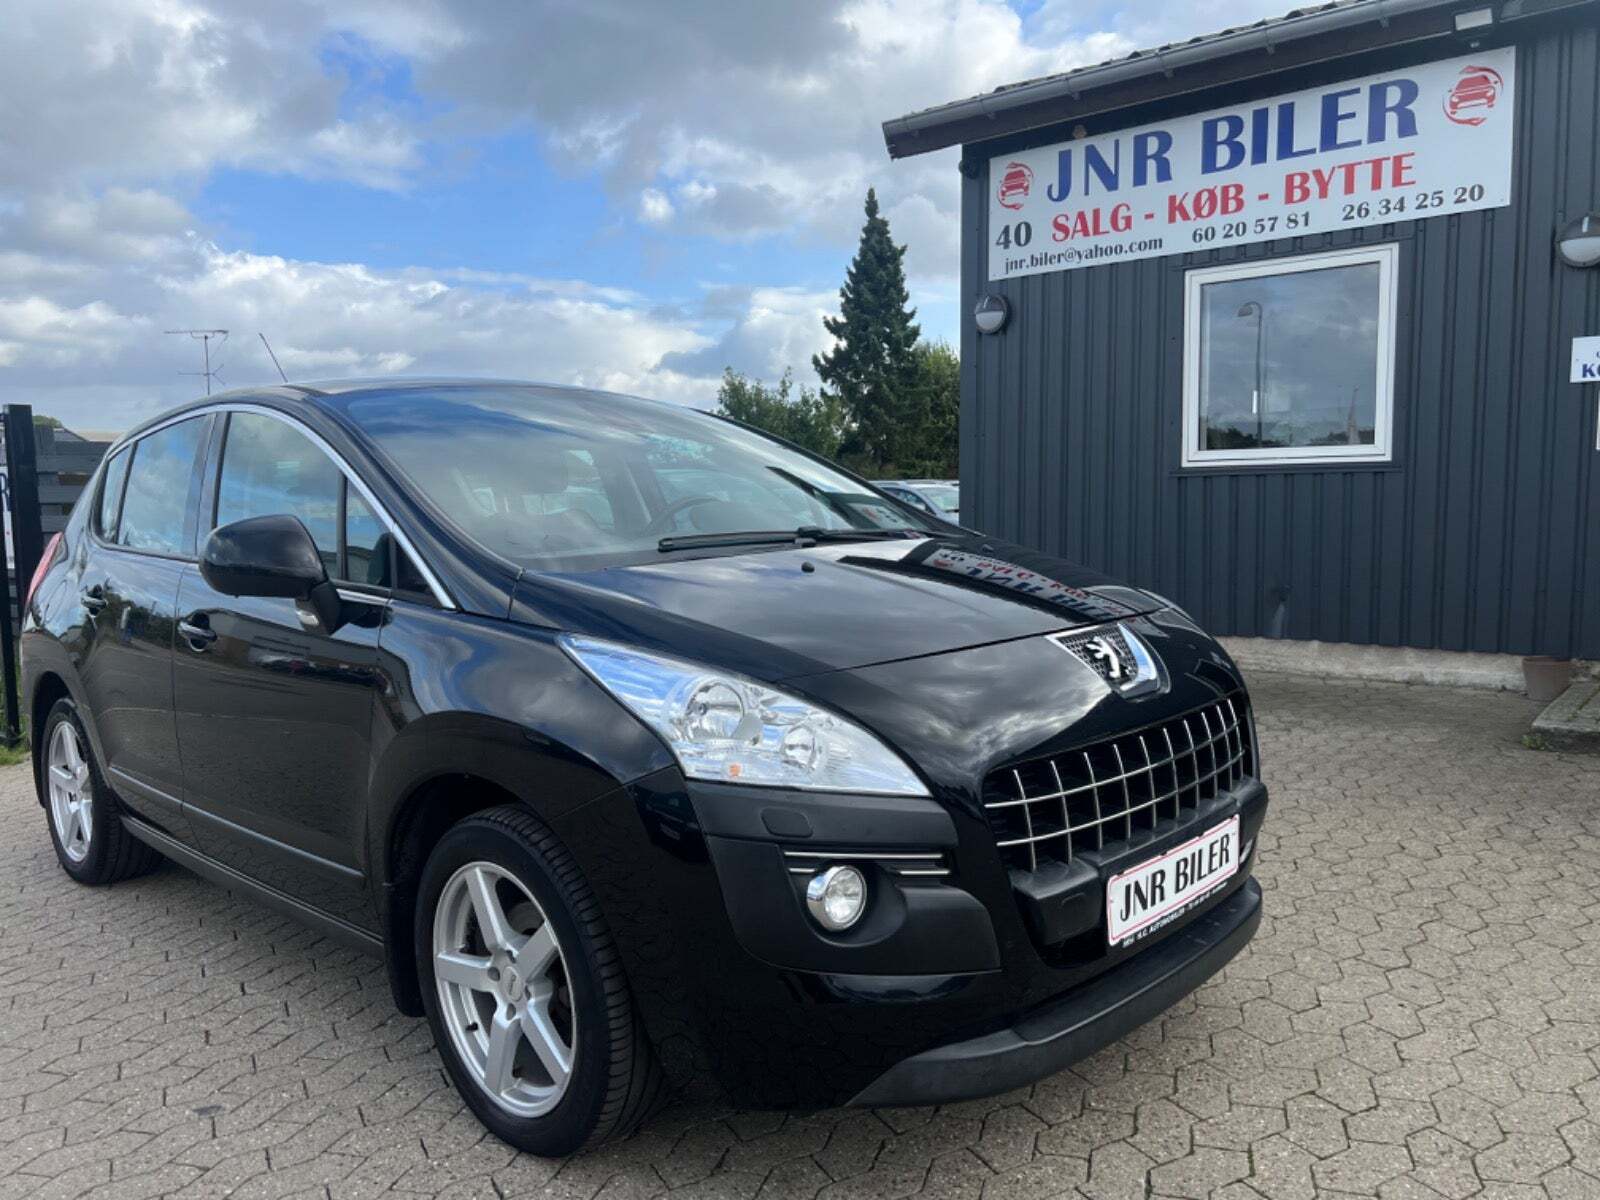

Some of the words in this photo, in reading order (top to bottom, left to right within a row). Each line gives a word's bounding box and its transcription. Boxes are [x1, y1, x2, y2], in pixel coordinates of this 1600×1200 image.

[1047, 130, 1173, 202] JNR
[1201, 78, 1419, 176] BILER
[1052, 202, 1133, 242] SALG
[1167, 183, 1245, 223] KØB
[1284, 151, 1416, 205] BYTTE
[1342, 201, 1370, 222] 26
[1378, 196, 1406, 217] 34
[1415, 190, 1444, 211] 25
[1453, 184, 1485, 205] 20
[996, 221, 1033, 250] 40
[1192, 226, 1216, 244] 60
[1222, 221, 1247, 239] 20
[1254, 215, 1279, 235] 57
[1286, 211, 1310, 230] 81
[1005, 237, 1164, 275] jnr.biler@yahoo.com
[1582, 363, 1600, 378] K
[1120, 869, 1166, 921] JNR
[1175, 834, 1230, 894] BILER
